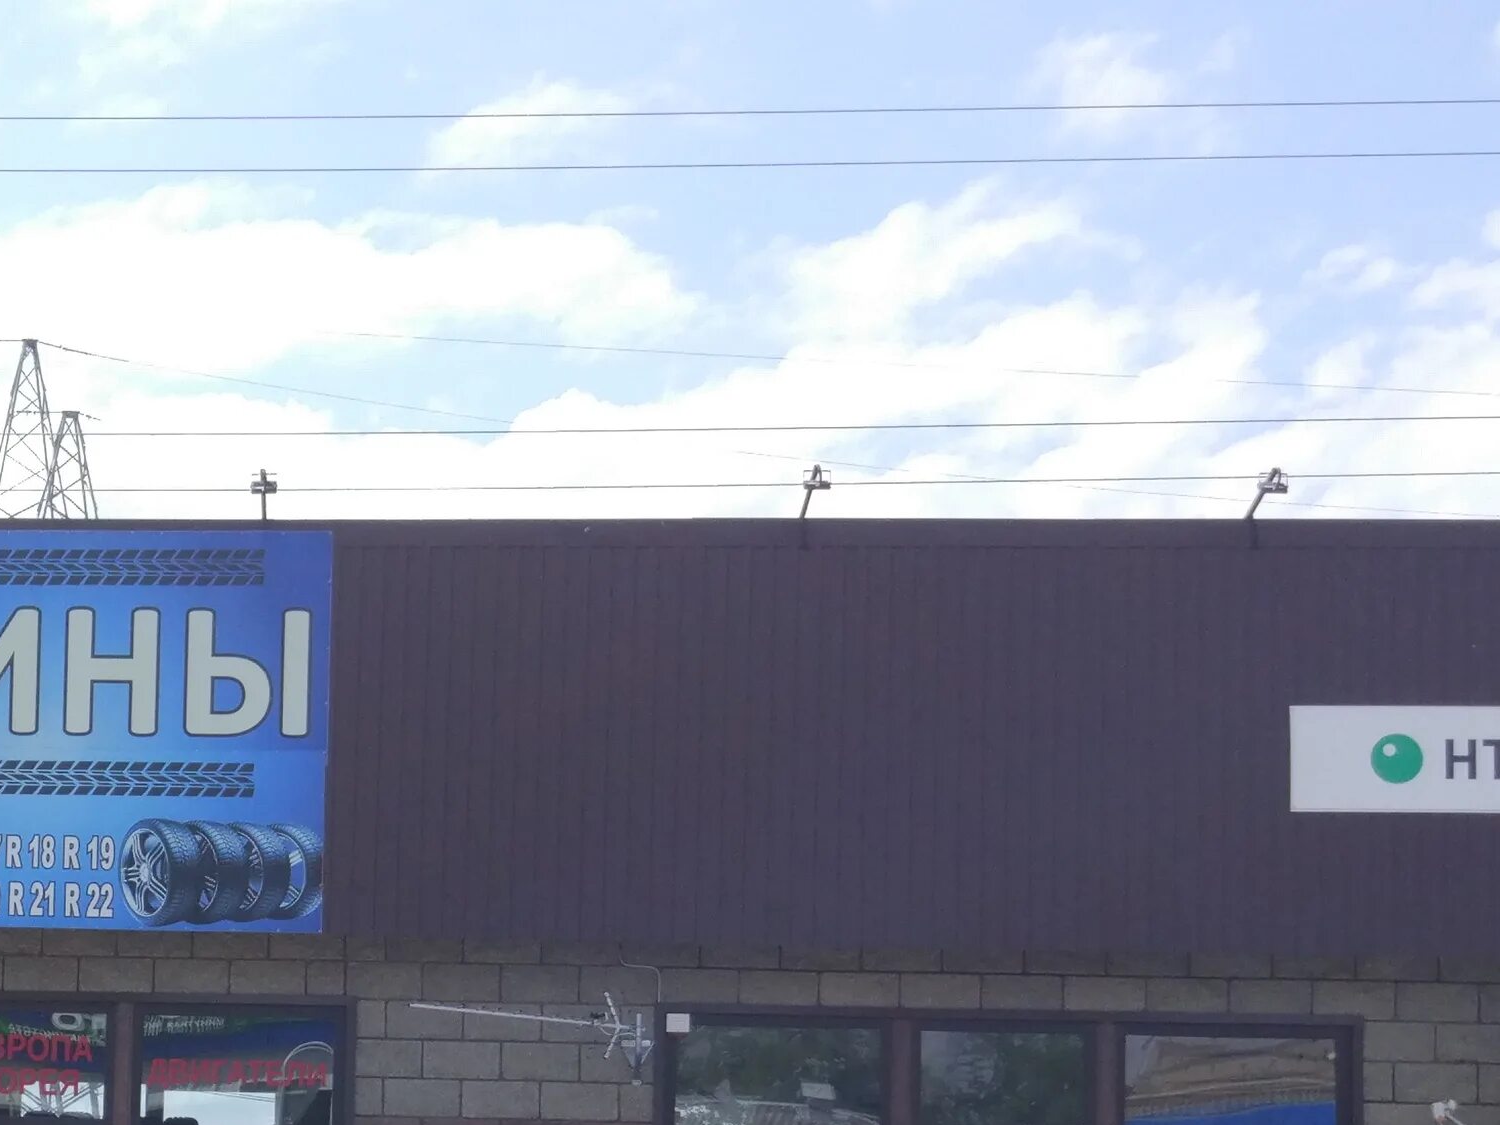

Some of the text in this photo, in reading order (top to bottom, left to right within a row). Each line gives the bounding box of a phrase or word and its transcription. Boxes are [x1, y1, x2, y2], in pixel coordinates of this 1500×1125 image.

[5, 834, 22, 869] R
[29, 834, 55, 869] 18
[63, 835, 80, 870] R
[87, 835, 115, 871] 19
[8, 881, 25, 916] R
[29, 881, 55, 917] 21
[64, 881, 80, 918] R
[85, 882, 114, 918] 22
[147, 1058, 328, 1088] ДВИГАТЕЛИ
